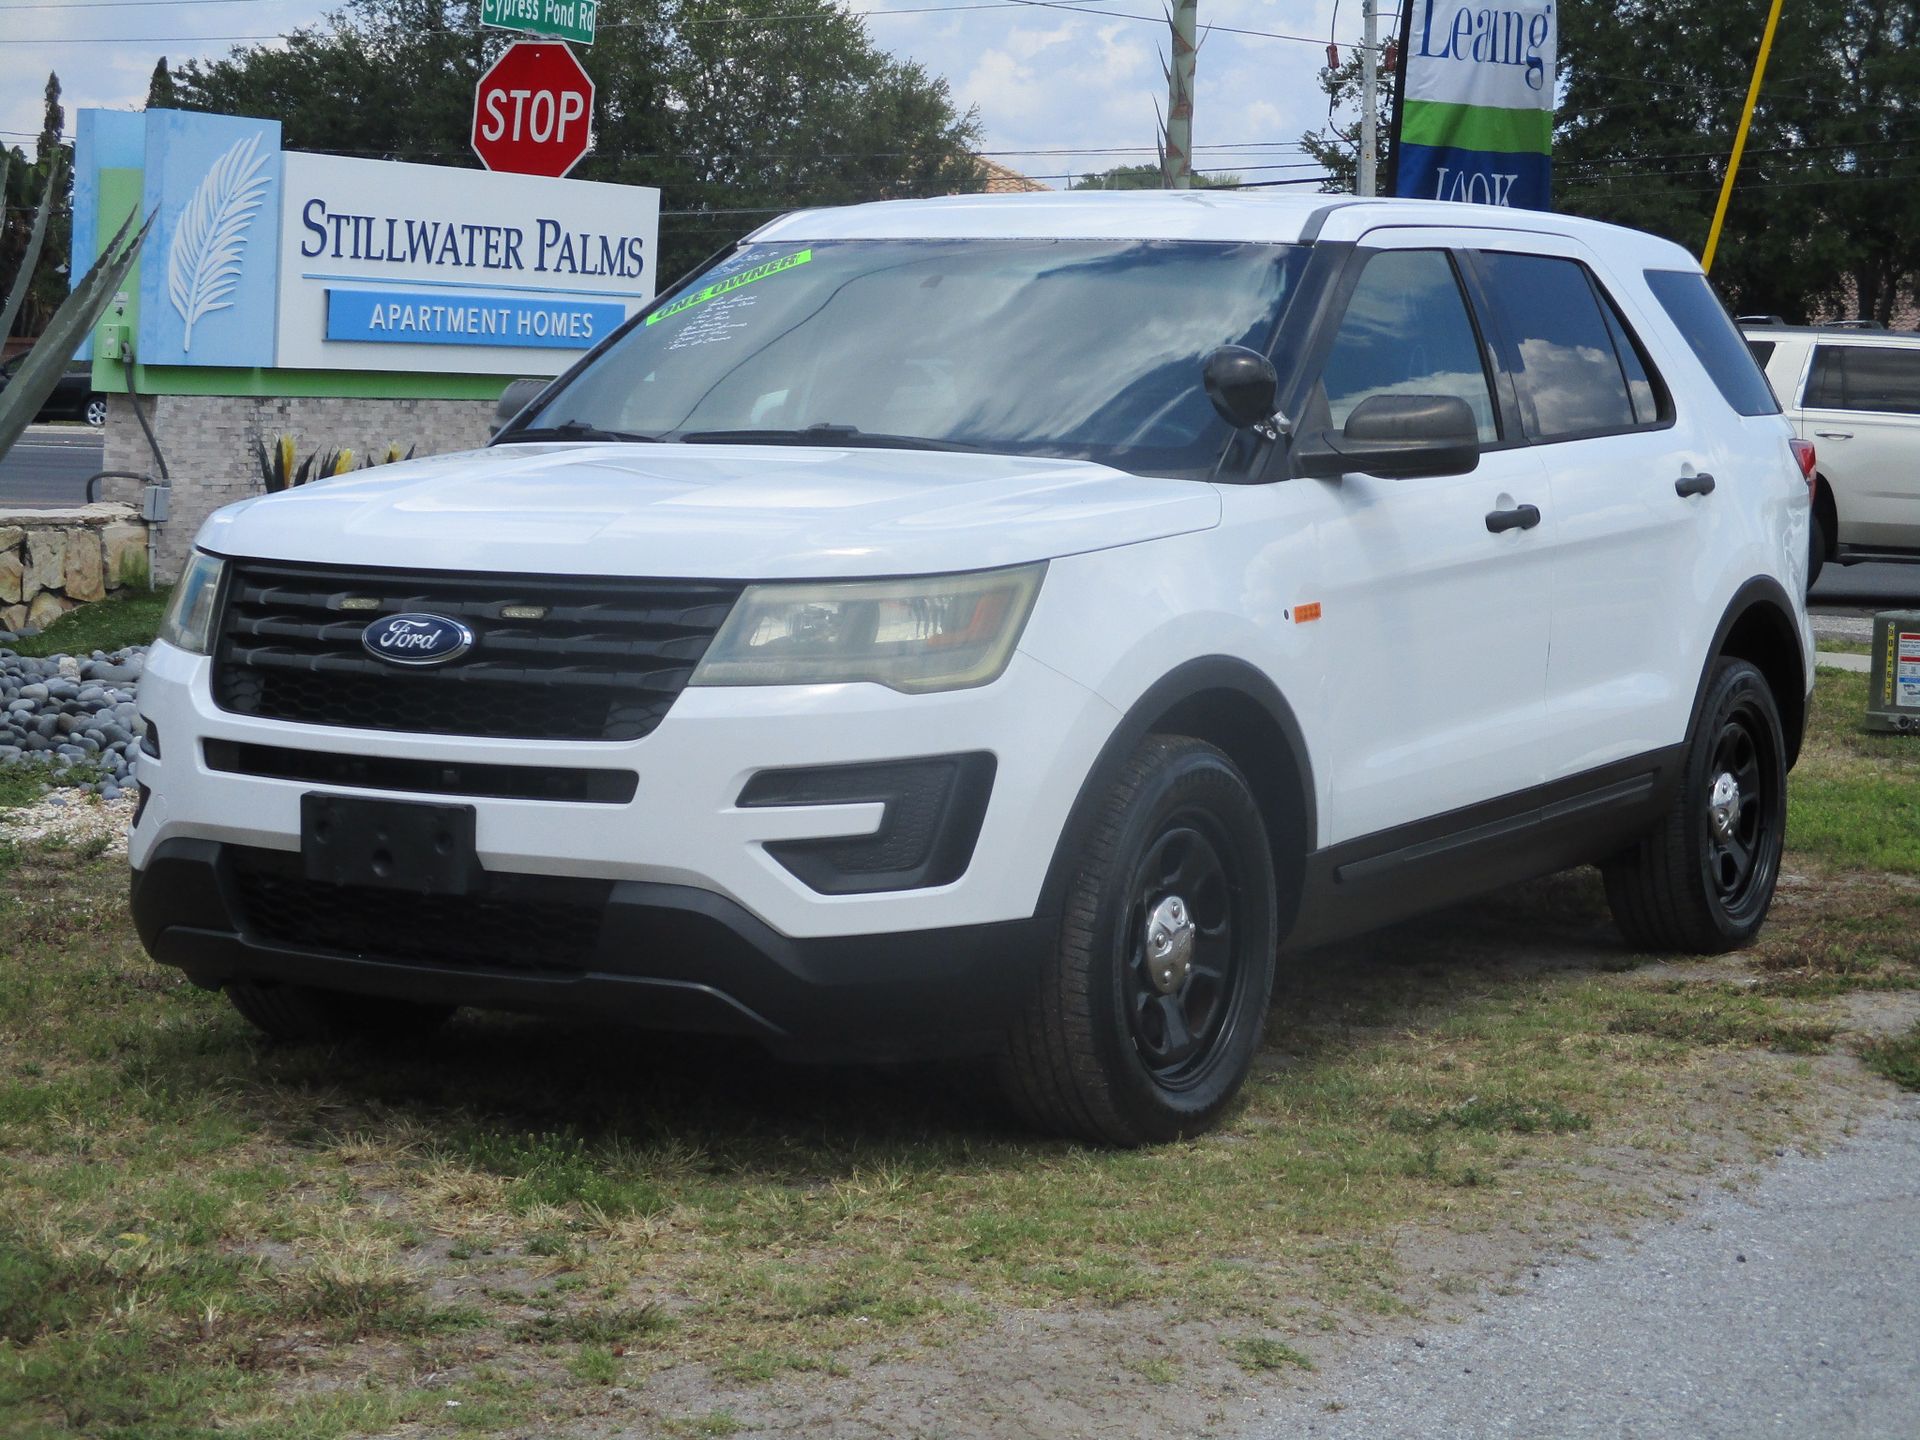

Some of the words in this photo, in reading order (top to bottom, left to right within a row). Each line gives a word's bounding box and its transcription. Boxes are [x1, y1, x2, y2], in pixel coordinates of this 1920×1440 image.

[485, 0, 539, 22] Cypress
[545, 0, 575, 28] Pond
[578, 3, 593, 32] Rd
[482, 88, 584, 143] STOP
[301, 198, 524, 270] STILLWATER
[534, 218, 644, 279] PALMS
[369, 303, 511, 336] APARTMENT
[517, 309, 594, 339] HOMES
[656, 291, 706, 319] ONE
[380, 619, 442, 650] Ford
